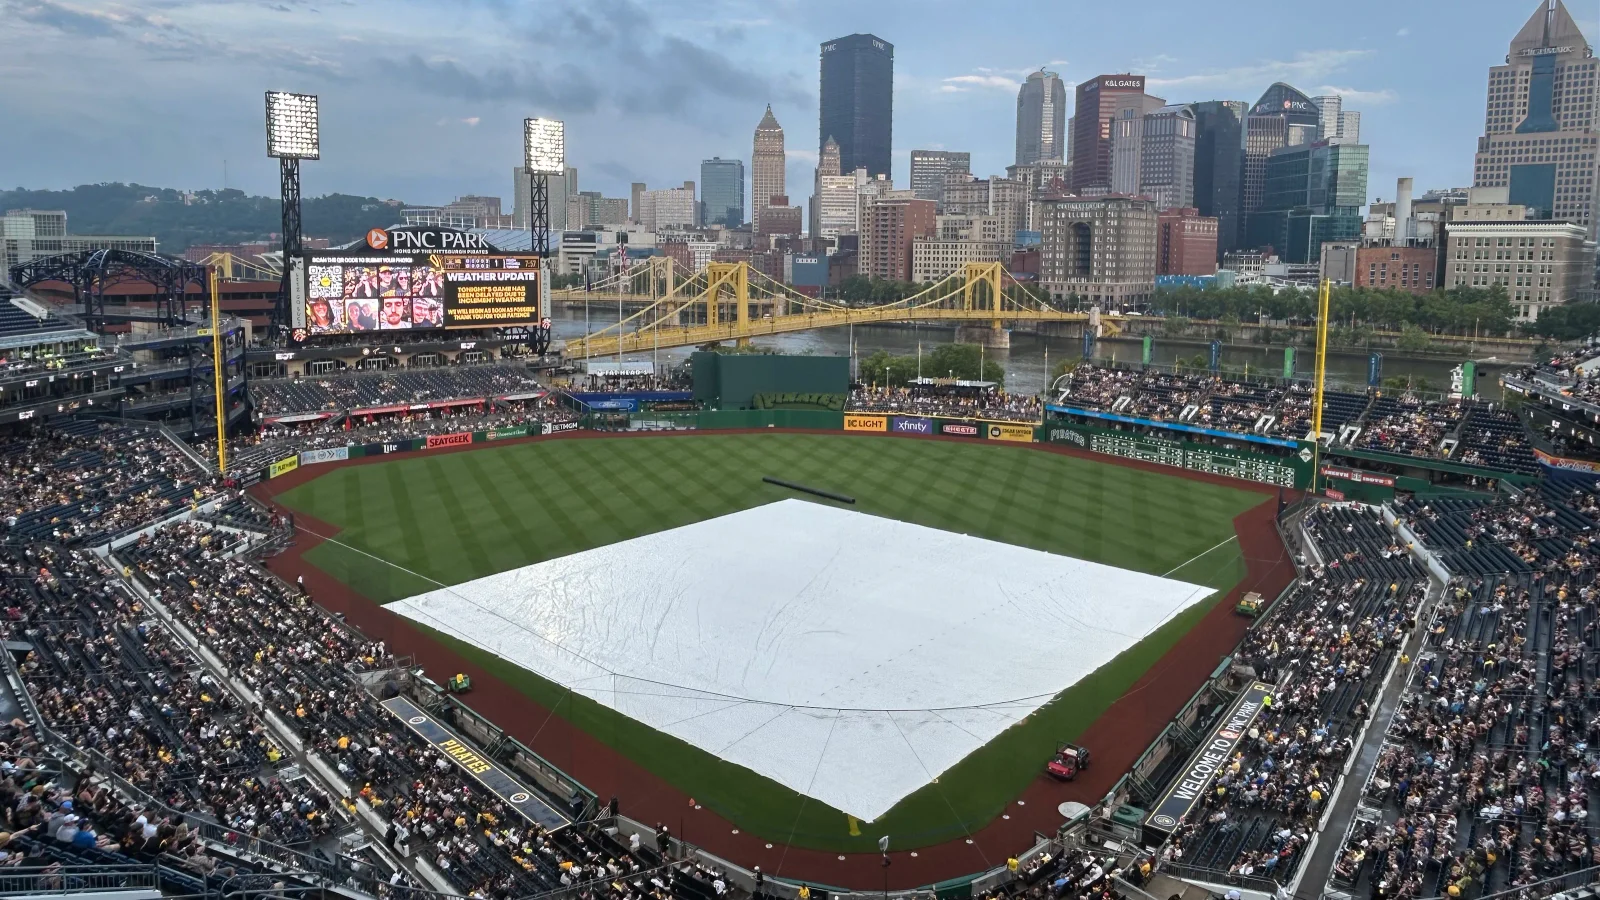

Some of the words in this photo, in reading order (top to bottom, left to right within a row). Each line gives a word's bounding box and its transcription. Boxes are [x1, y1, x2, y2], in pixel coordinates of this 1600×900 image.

[1291, 101, 1307, 110] PNC
[391, 231, 435, 248] PNC
[440, 232, 489, 249] PARK
[447, 273, 497, 281] WEATHER
[497, 272, 535, 281] UPDATE
[552, 422, 578, 431] BETMGM
[859, 420, 883, 428] LIGHT
[898, 420, 927, 432] xfinity
[429, 434, 469, 447] SEATGEEK
[1051, 429, 1085, 446] PIRATES
[1556, 459, 1593, 472] Surfside
[439, 739, 491, 774] PIRATES
[1173, 751, 1222, 800] WELCOME
[1209, 739, 1232, 756] TO
[1226, 715, 1249, 733] PNC
[1239, 700, 1260, 717] PARK
